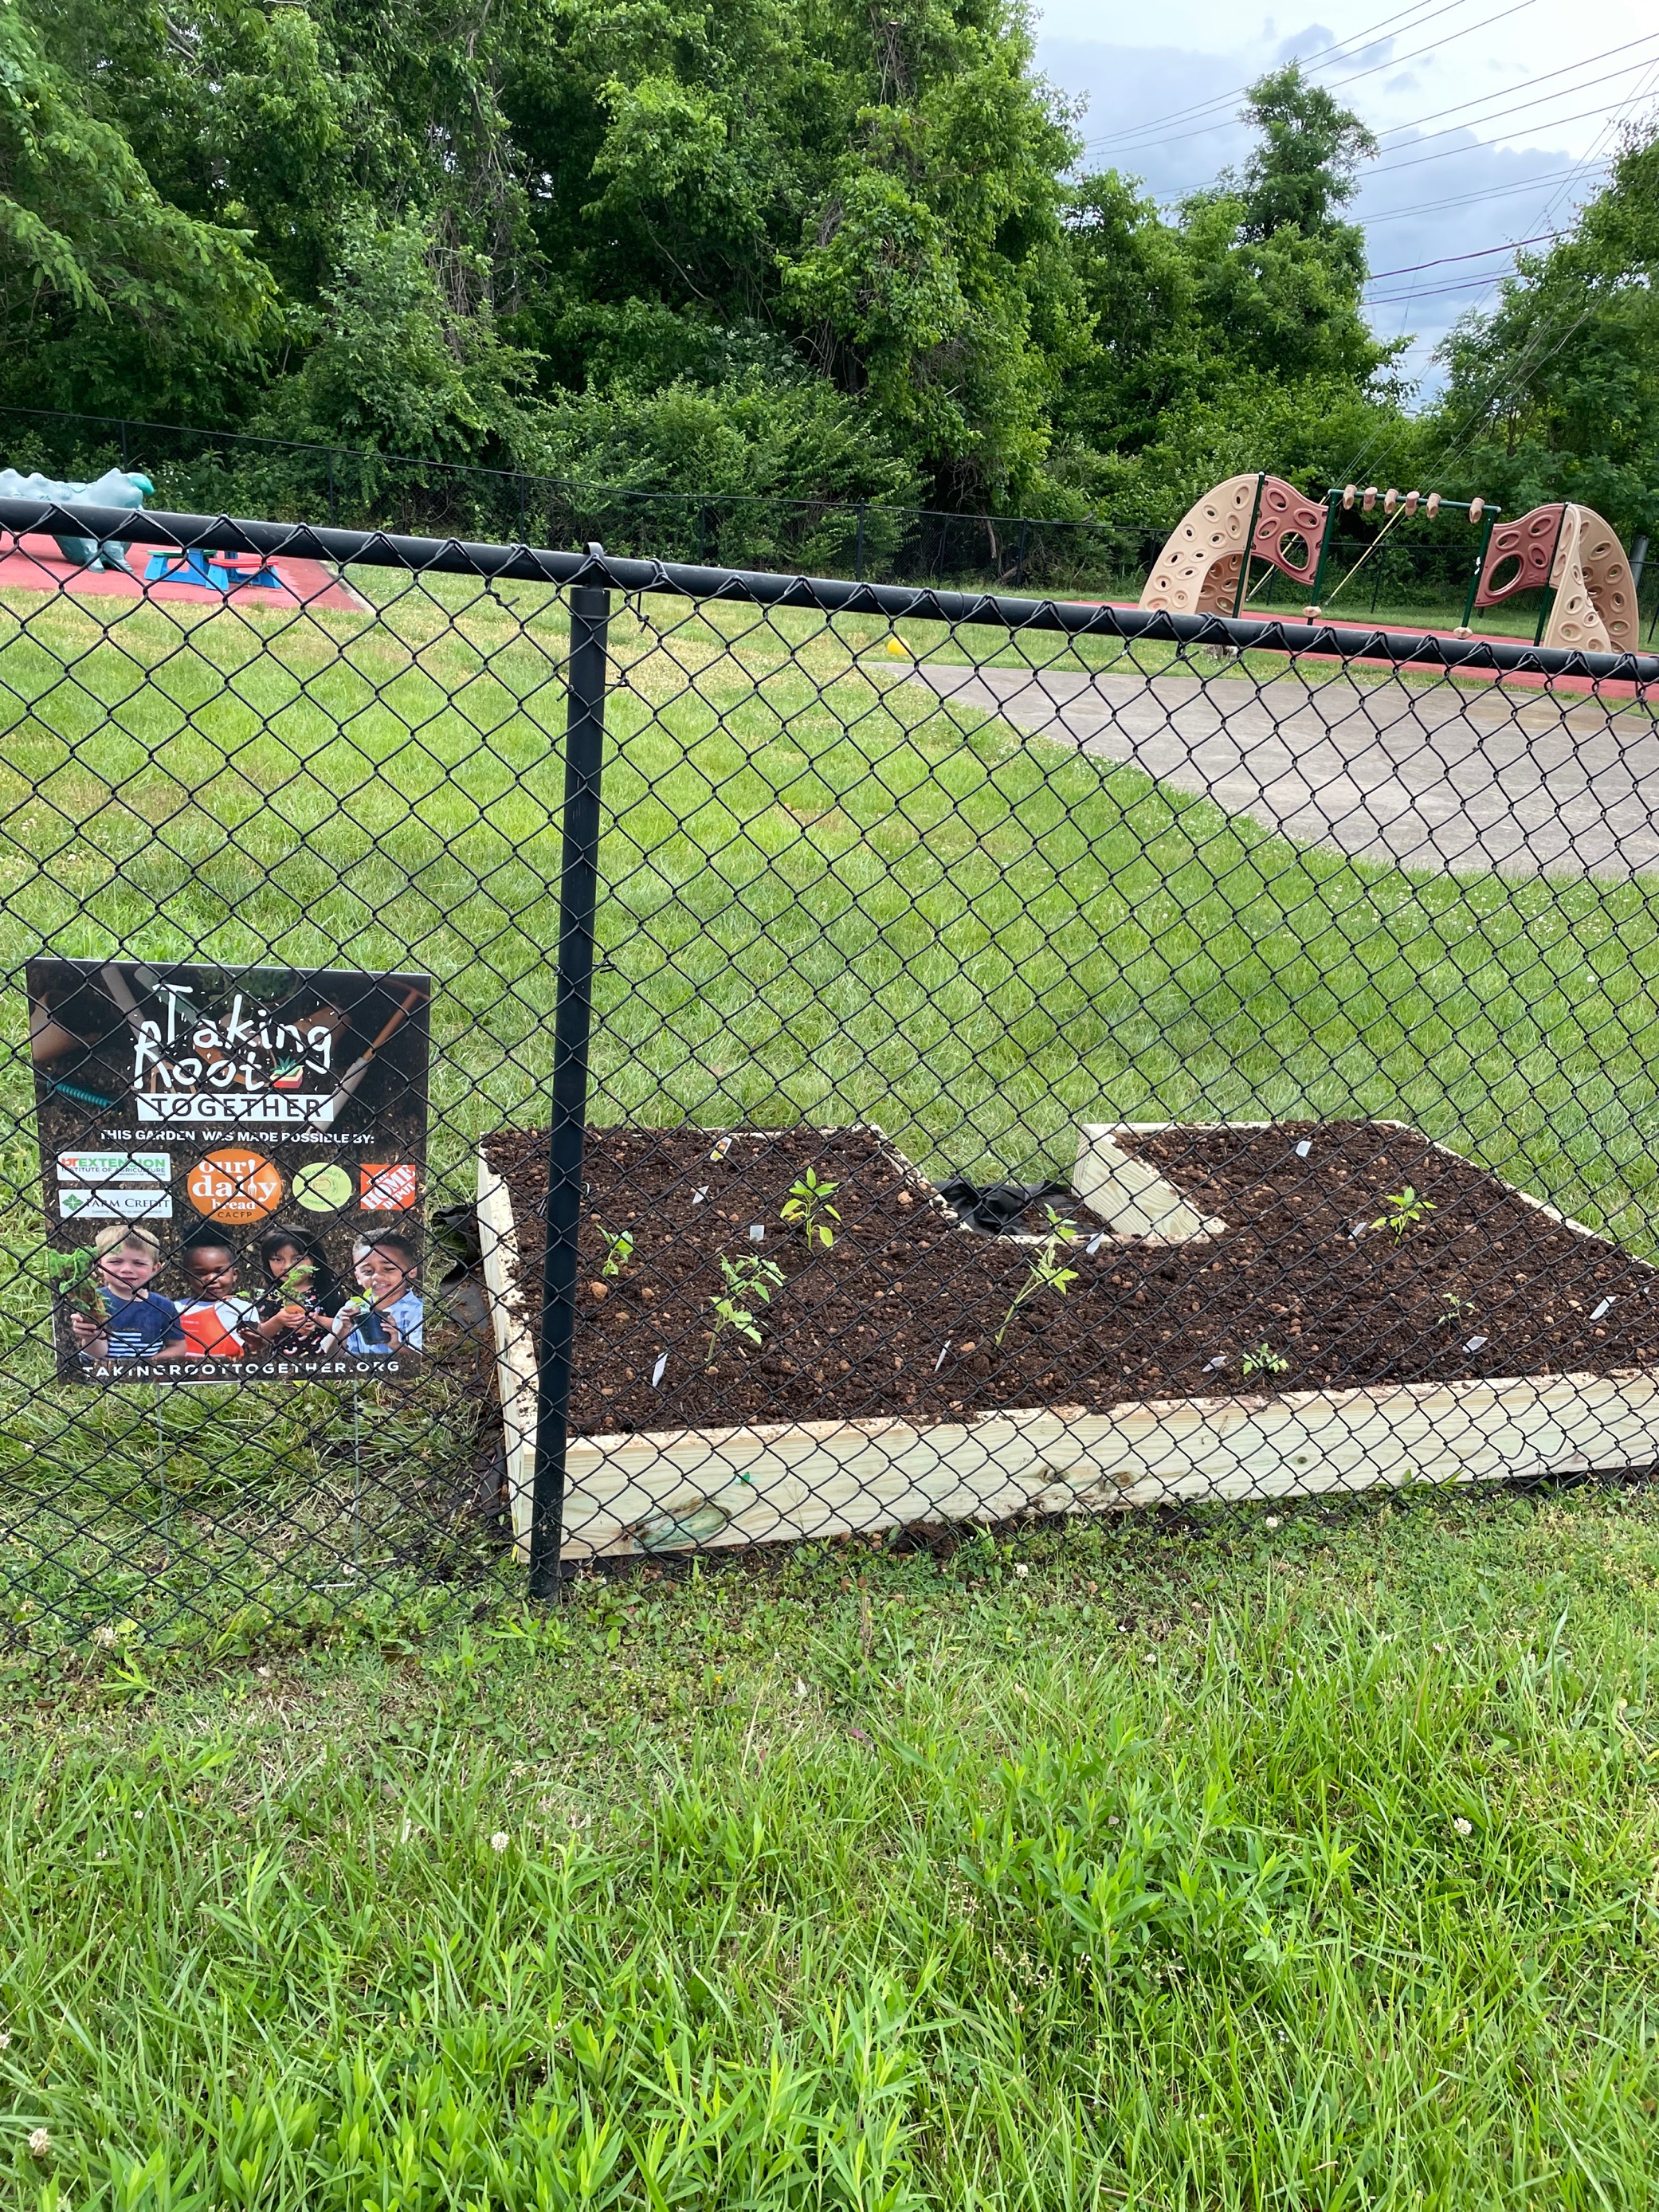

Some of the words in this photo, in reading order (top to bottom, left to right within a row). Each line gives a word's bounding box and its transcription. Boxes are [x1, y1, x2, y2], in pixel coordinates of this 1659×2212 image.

[152, 983, 332, 1074] Taking
[134, 1021, 265, 1091] Root
[151, 1098, 321, 1117] TOGETHER
[101, 1130, 131, 1140] THIS
[135, 1130, 195, 1141] GARDEN
[202, 1131, 234, 1141] WAS
[237, 1131, 278, 1142] MADE
[281, 1132, 349, 1143] POSSIBLE
[353, 1134, 375, 1143] BY:
[198, 1161, 247, 1174] our
[361, 1165, 415, 1210] HOME
[212, 1198, 256, 1210] bread
